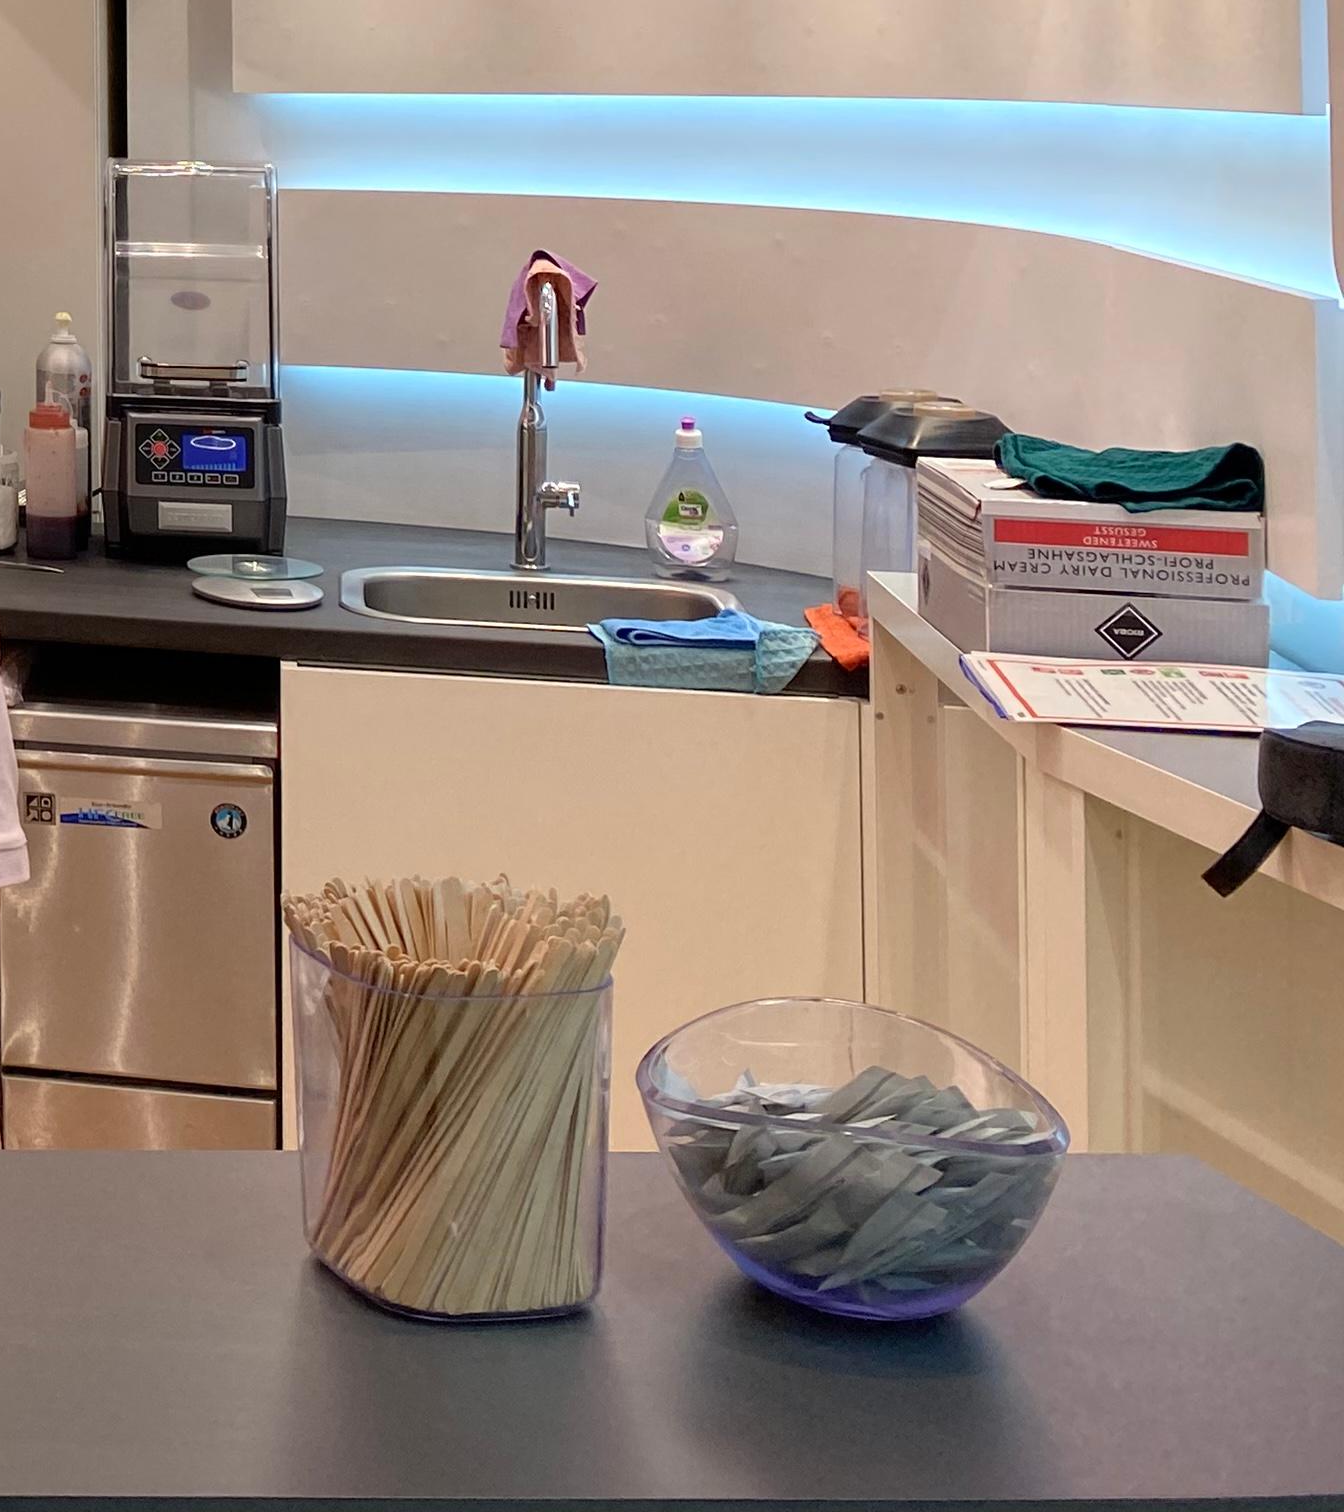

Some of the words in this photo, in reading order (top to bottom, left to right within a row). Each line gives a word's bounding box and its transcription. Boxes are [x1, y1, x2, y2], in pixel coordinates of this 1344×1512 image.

[1083, 536, 1158, 547] SWEETENED
[1028, 548, 1213, 569] PROFI-SCHLAGSAHNE
[994, 560, 1050, 574] CREAM
[1062, 562, 1111, 577] DAIRY
[1123, 568, 1250, 585] PROFESSIONAL
